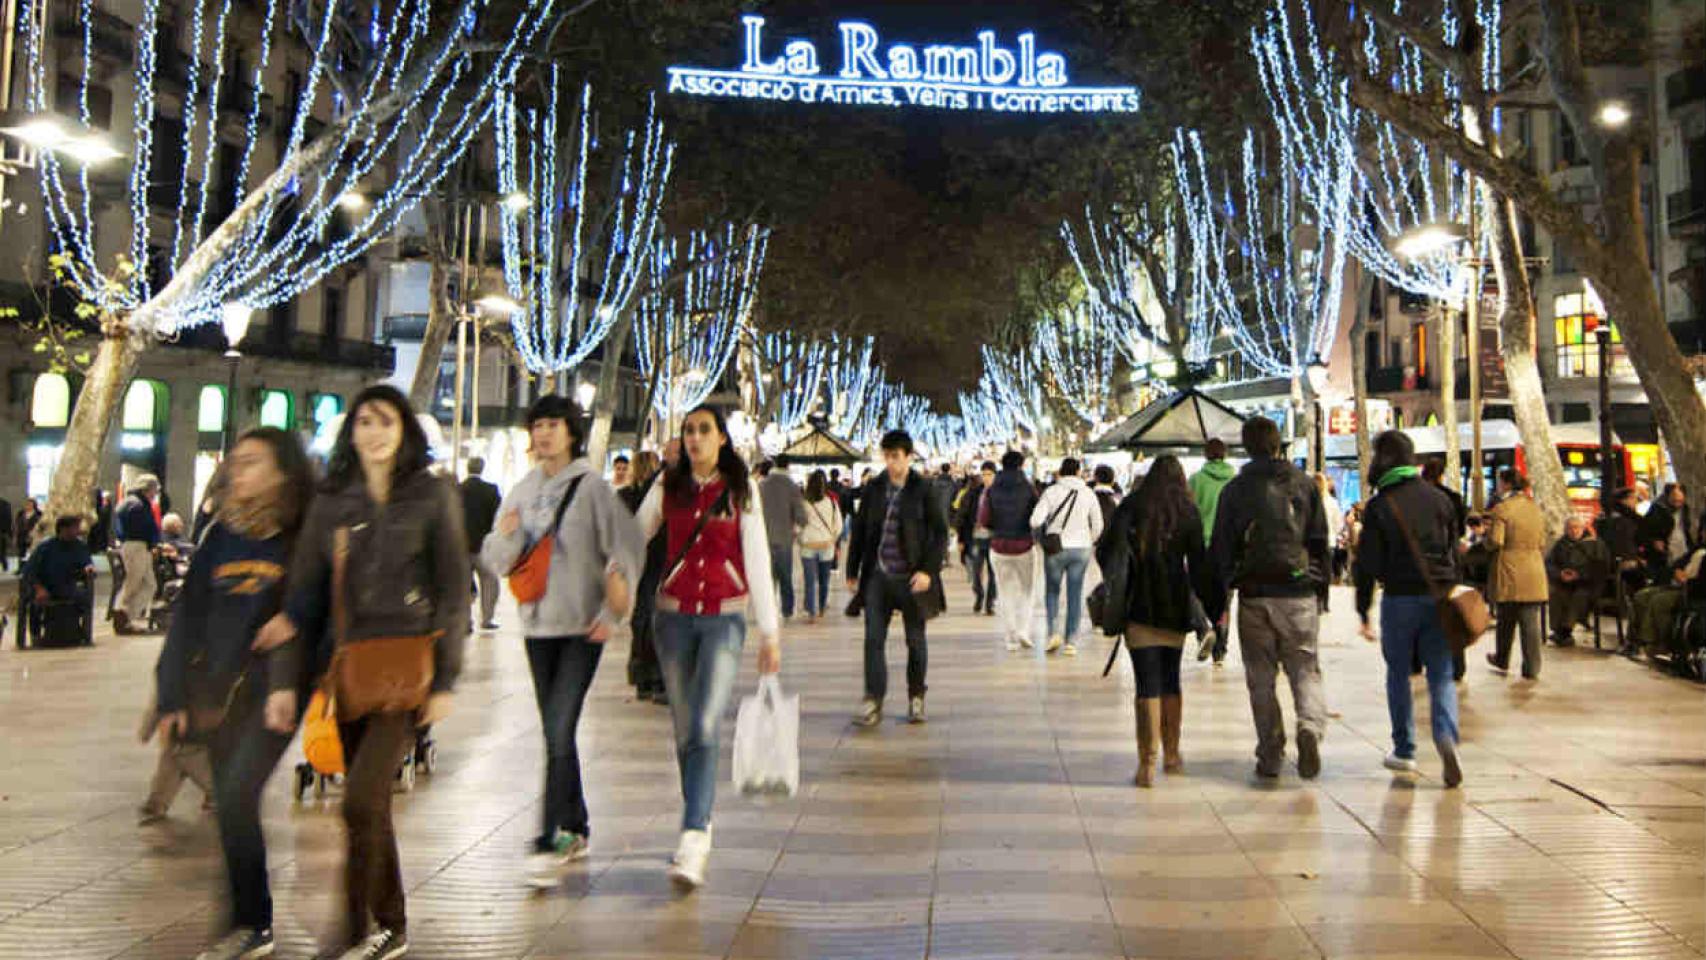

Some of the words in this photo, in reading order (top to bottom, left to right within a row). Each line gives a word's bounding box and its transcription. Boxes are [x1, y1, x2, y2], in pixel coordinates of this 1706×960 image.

[742, 16, 820, 75] La
[838, 22, 1068, 86] Rambla
[991, 91, 1139, 112] Comerciants
